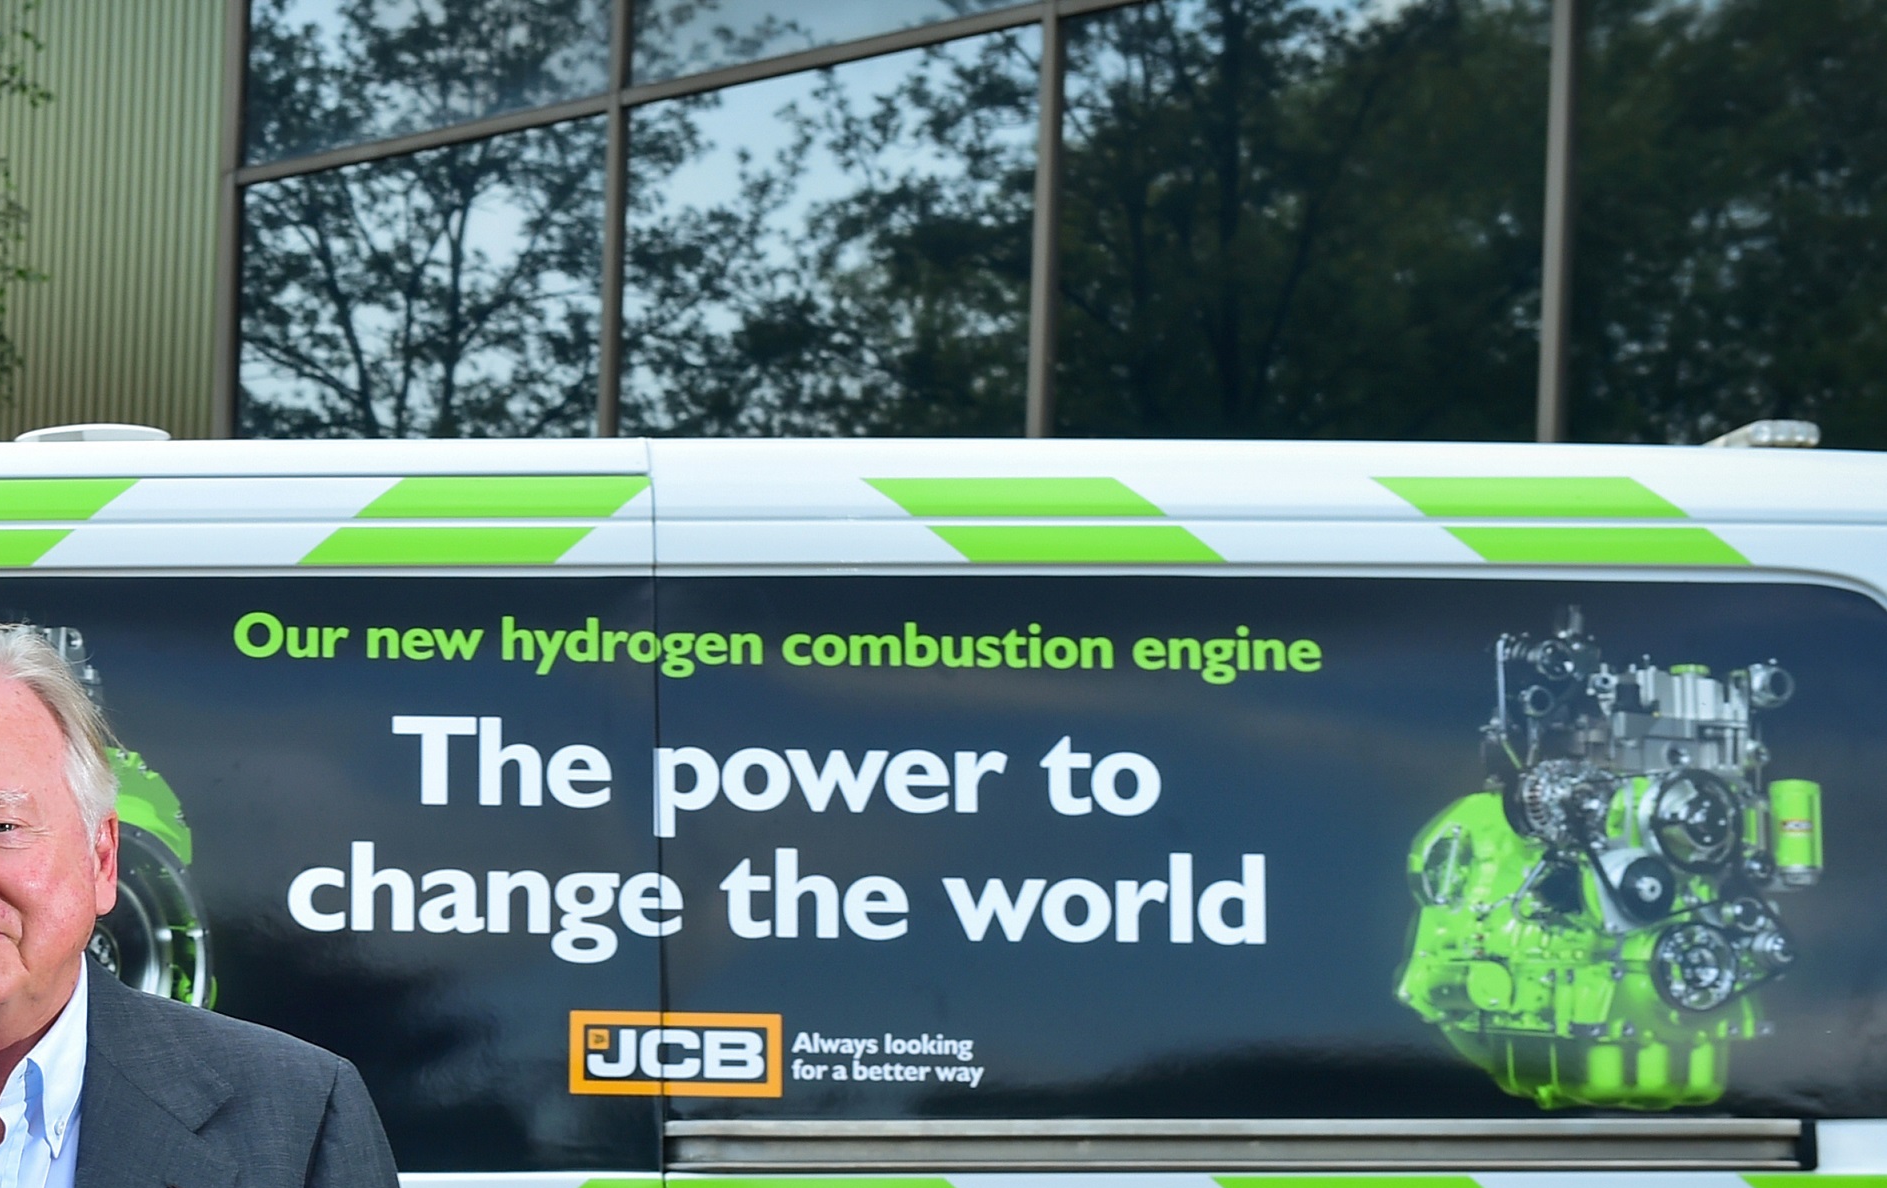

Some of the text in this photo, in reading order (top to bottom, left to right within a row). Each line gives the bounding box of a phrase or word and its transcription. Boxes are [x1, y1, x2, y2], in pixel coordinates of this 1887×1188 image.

[233, 611, 1322, 685] Our new hydrogen combustion engine
[392, 715, 1161, 837] The power to
[287, 841, 1266, 964] change the world
[586, 1028, 764, 1079] JCB
[791, 1031, 974, 1061] Always looking
[791, 1058, 984, 1088] for a better way
